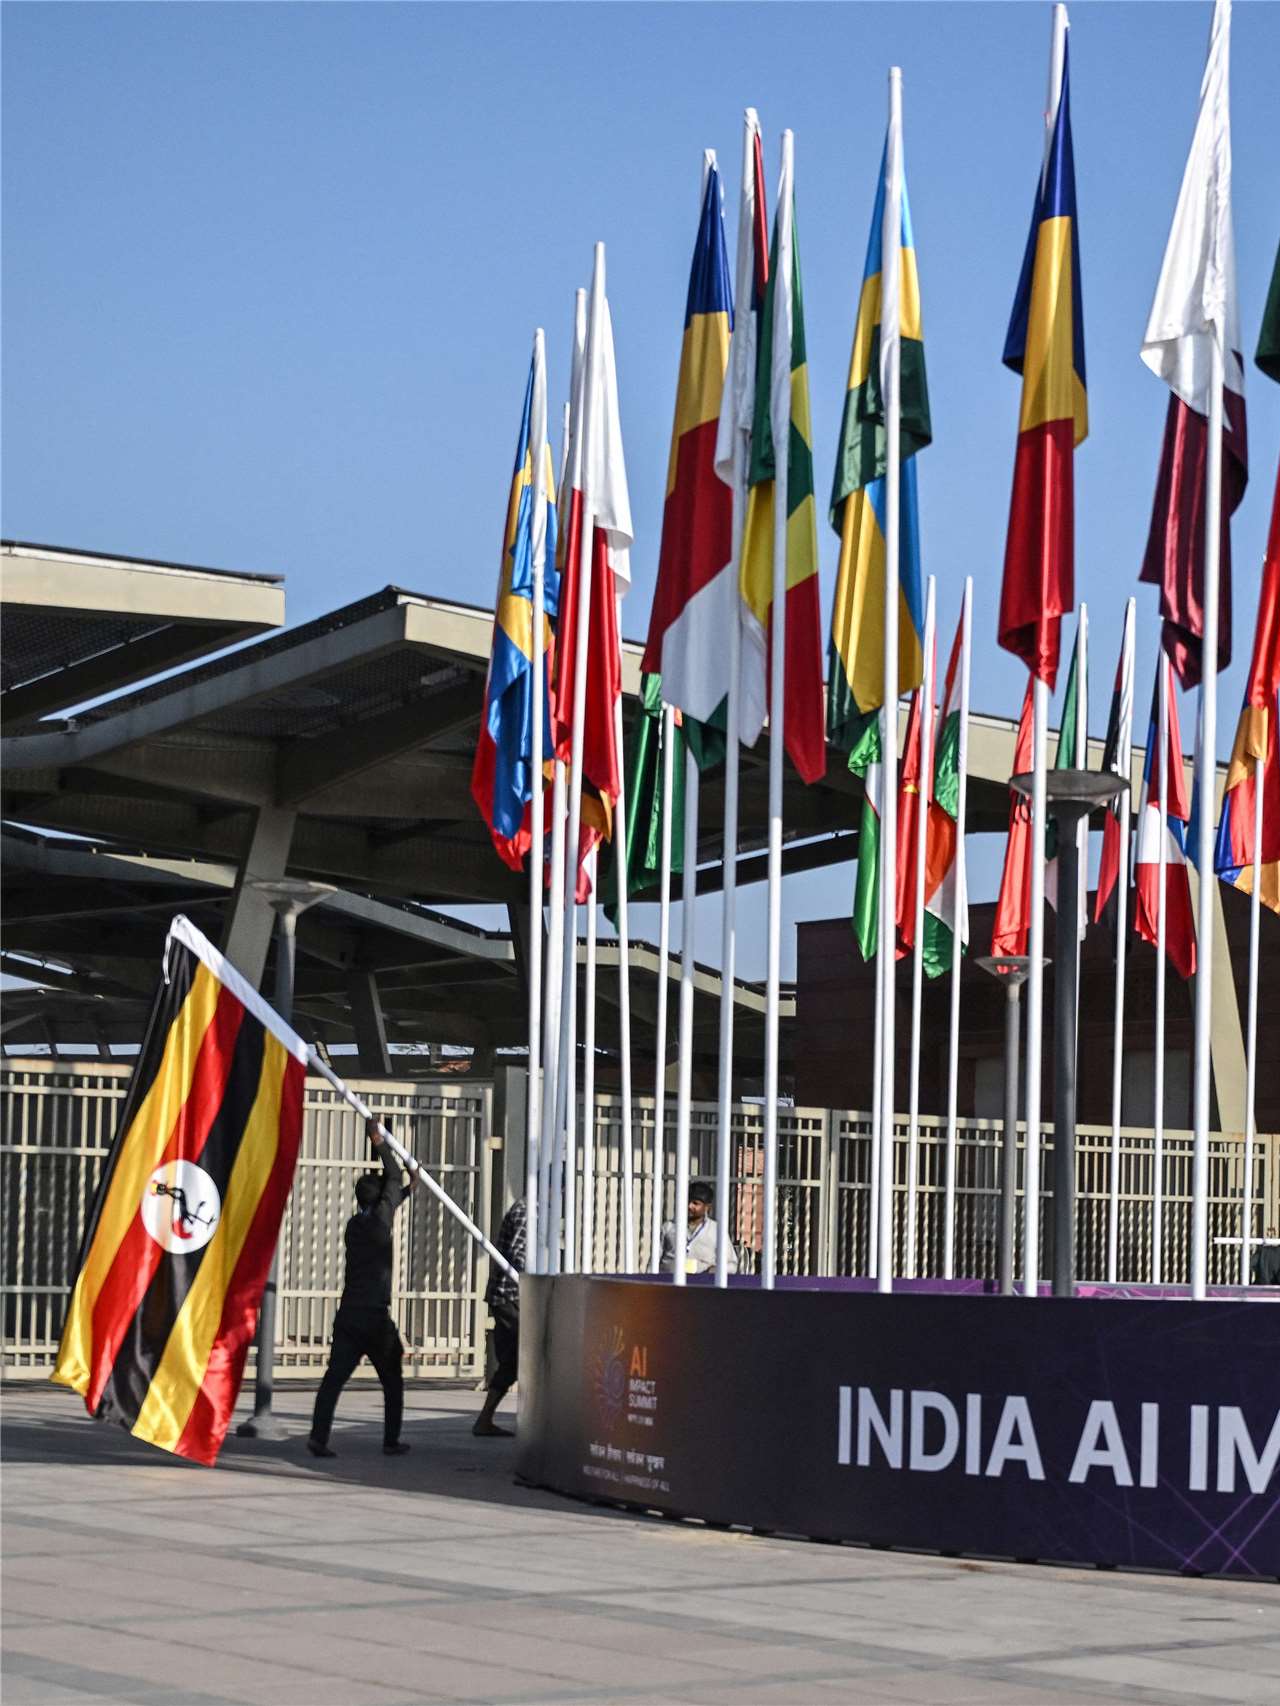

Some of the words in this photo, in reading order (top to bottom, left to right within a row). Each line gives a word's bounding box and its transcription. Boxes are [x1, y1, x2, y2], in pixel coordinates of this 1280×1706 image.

[630, 1345, 647, 1377] AI
[629, 1378, 656, 1395] IMPACT
[837, 1385, 1046, 1481] INDIA
[1068, 1400, 1159, 1488] AI
